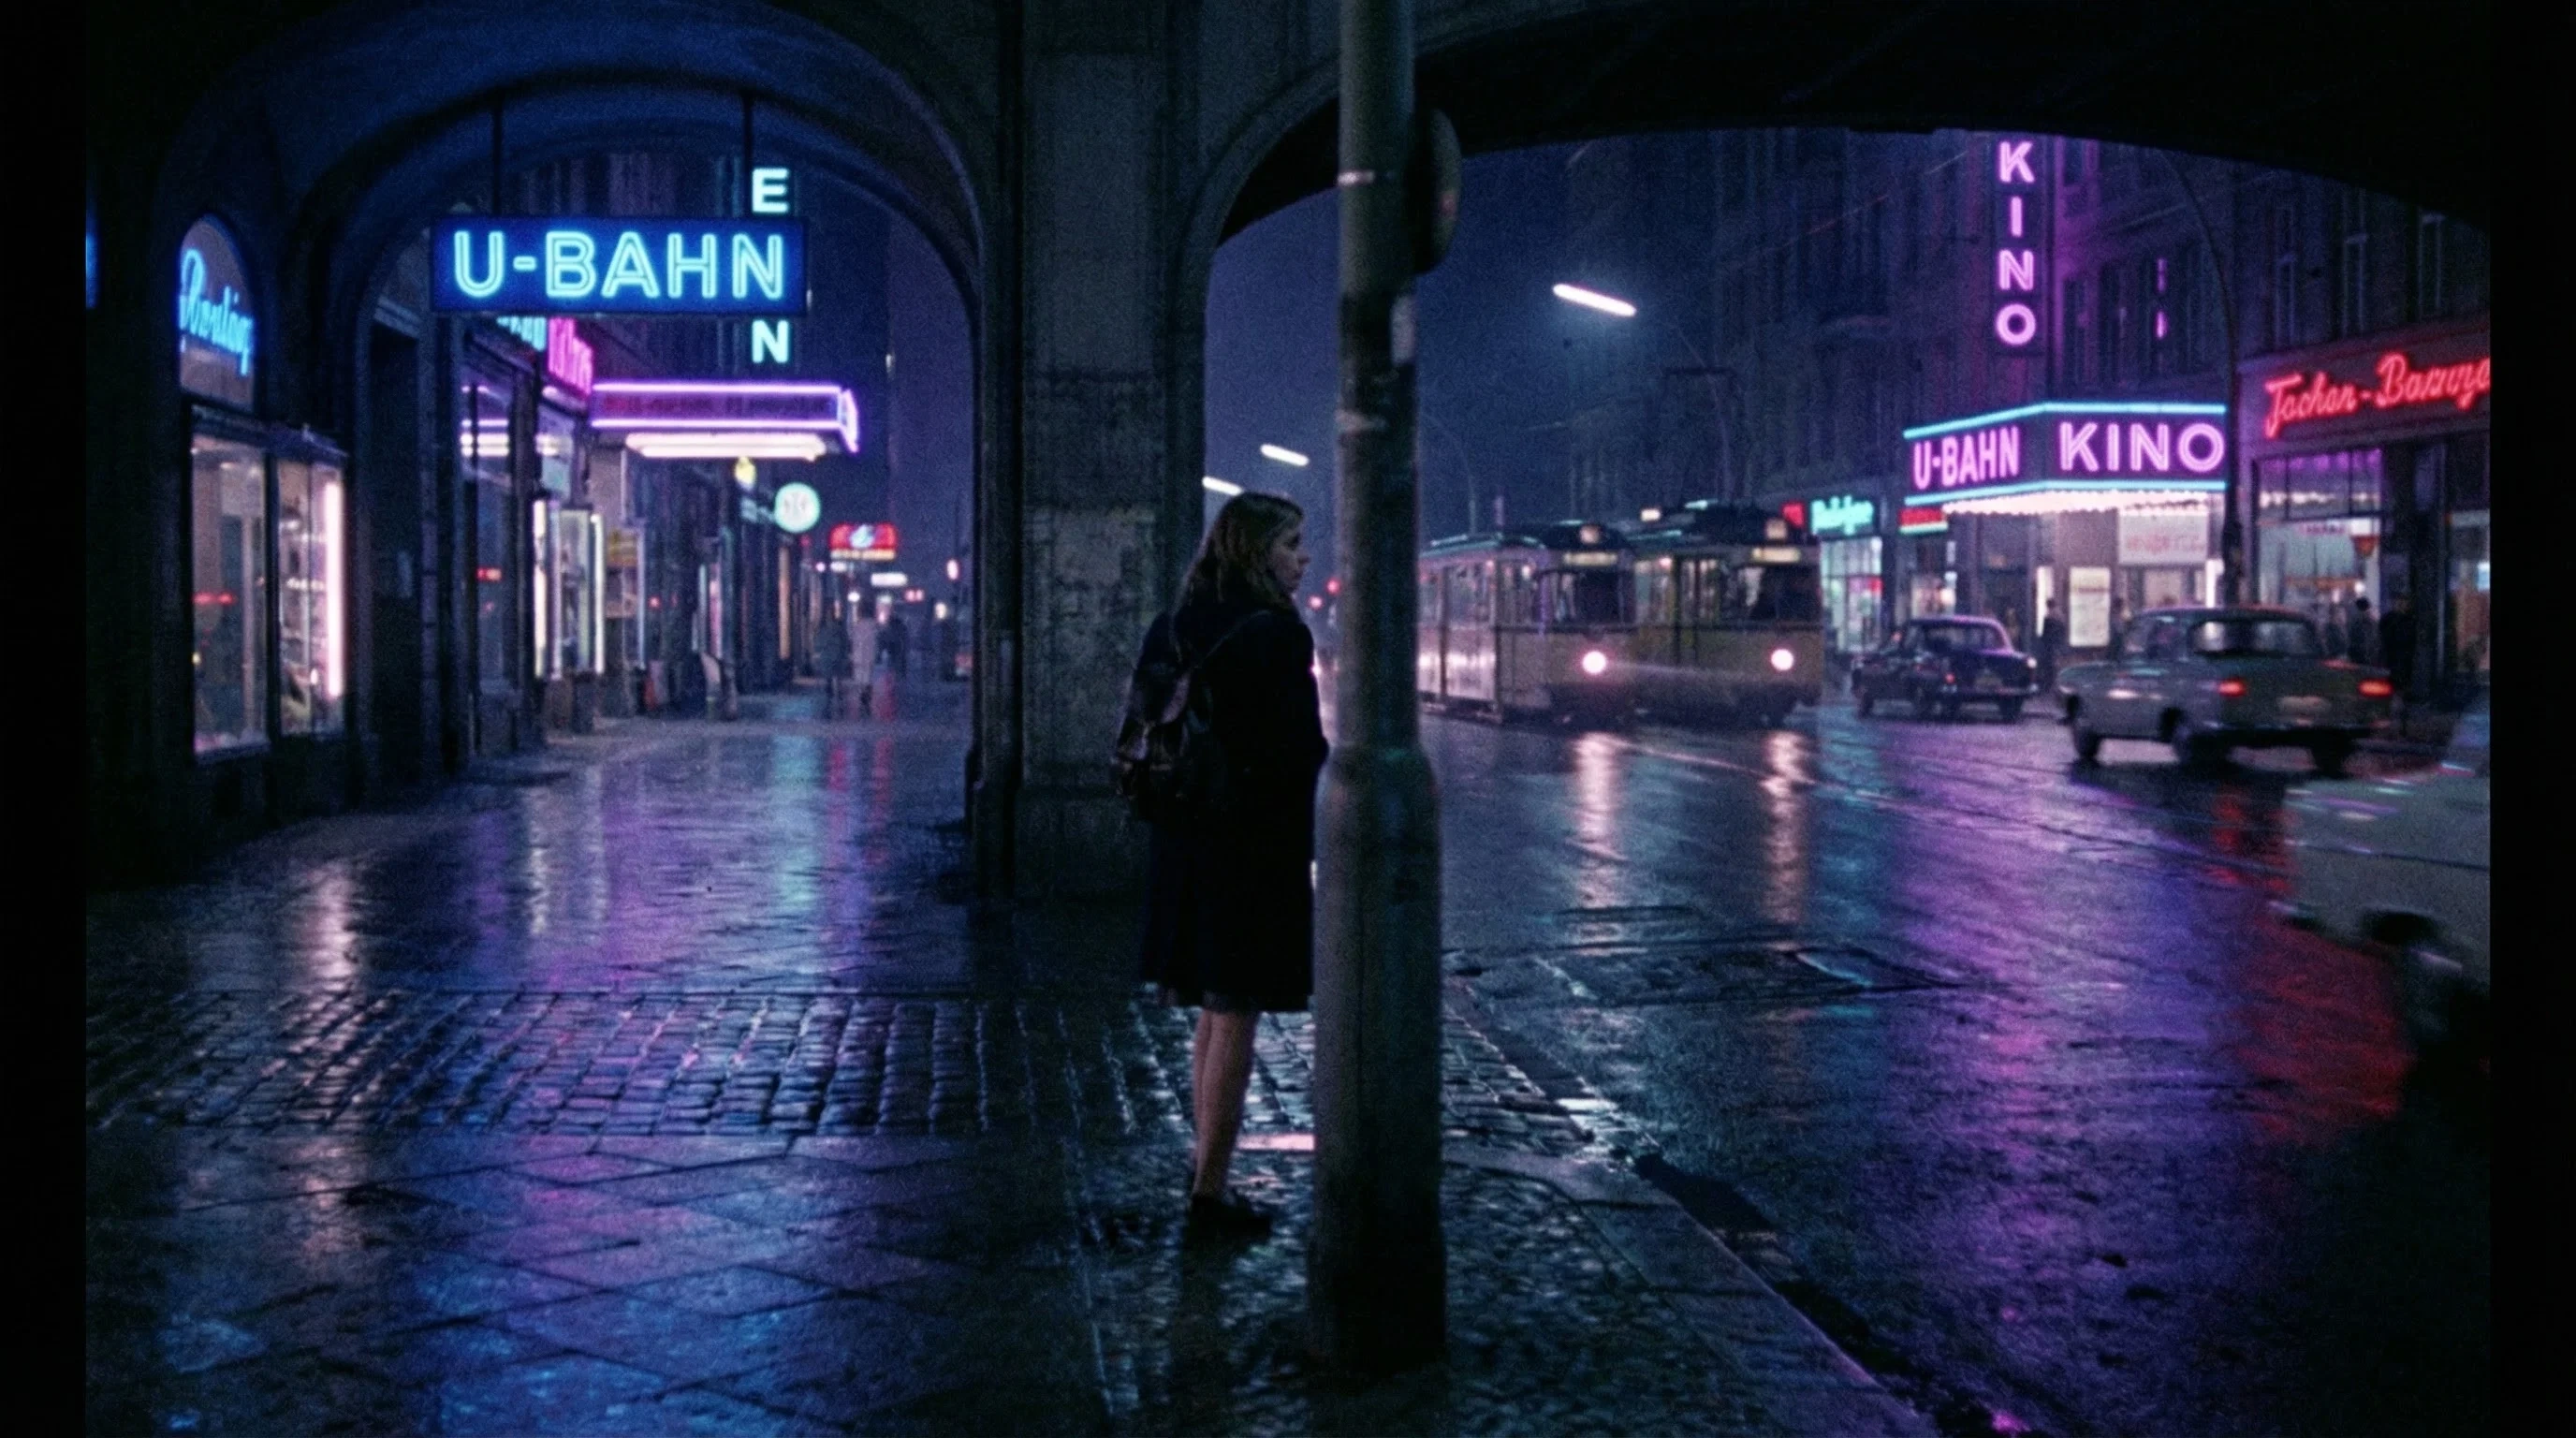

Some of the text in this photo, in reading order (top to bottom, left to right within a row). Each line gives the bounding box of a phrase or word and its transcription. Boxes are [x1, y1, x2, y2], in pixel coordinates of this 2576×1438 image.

[454, 230, 784, 300] U-BAHN
[1996, 140, 2037, 345] KINO
[1913, 426, 2020, 491] U-BAHN
[2059, 421, 2225, 473] KINO
